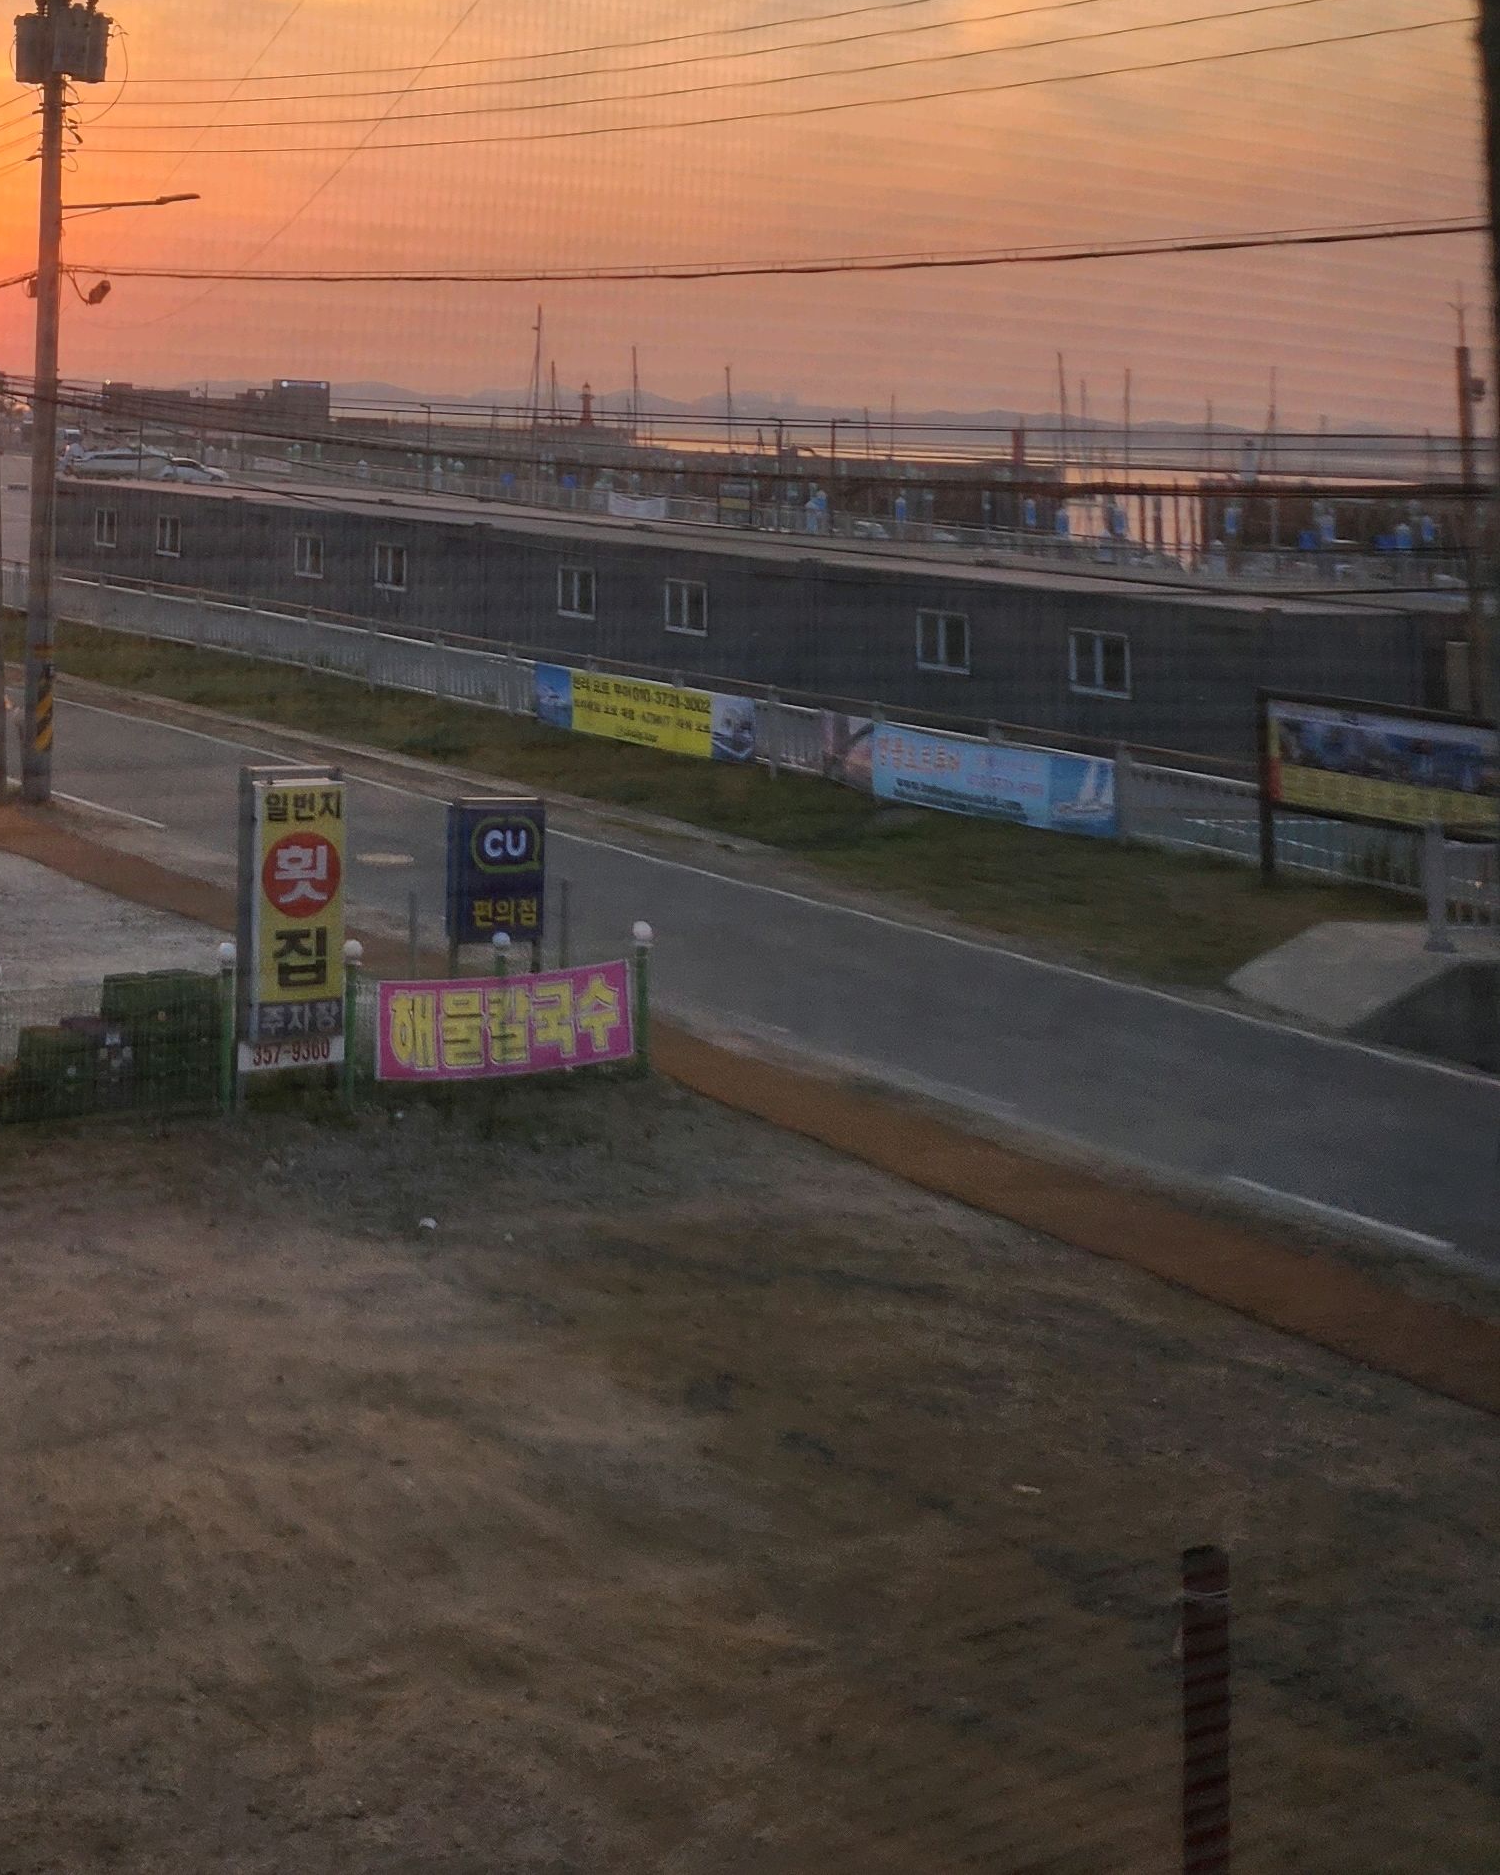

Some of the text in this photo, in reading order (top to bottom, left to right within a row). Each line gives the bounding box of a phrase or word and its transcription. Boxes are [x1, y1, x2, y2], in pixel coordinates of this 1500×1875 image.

[265, 790, 342, 822] 일번지
[484, 830, 527, 859] CU
[472, 896, 538, 928] 편의점
[390, 972, 621, 1072] 해물칼국수
